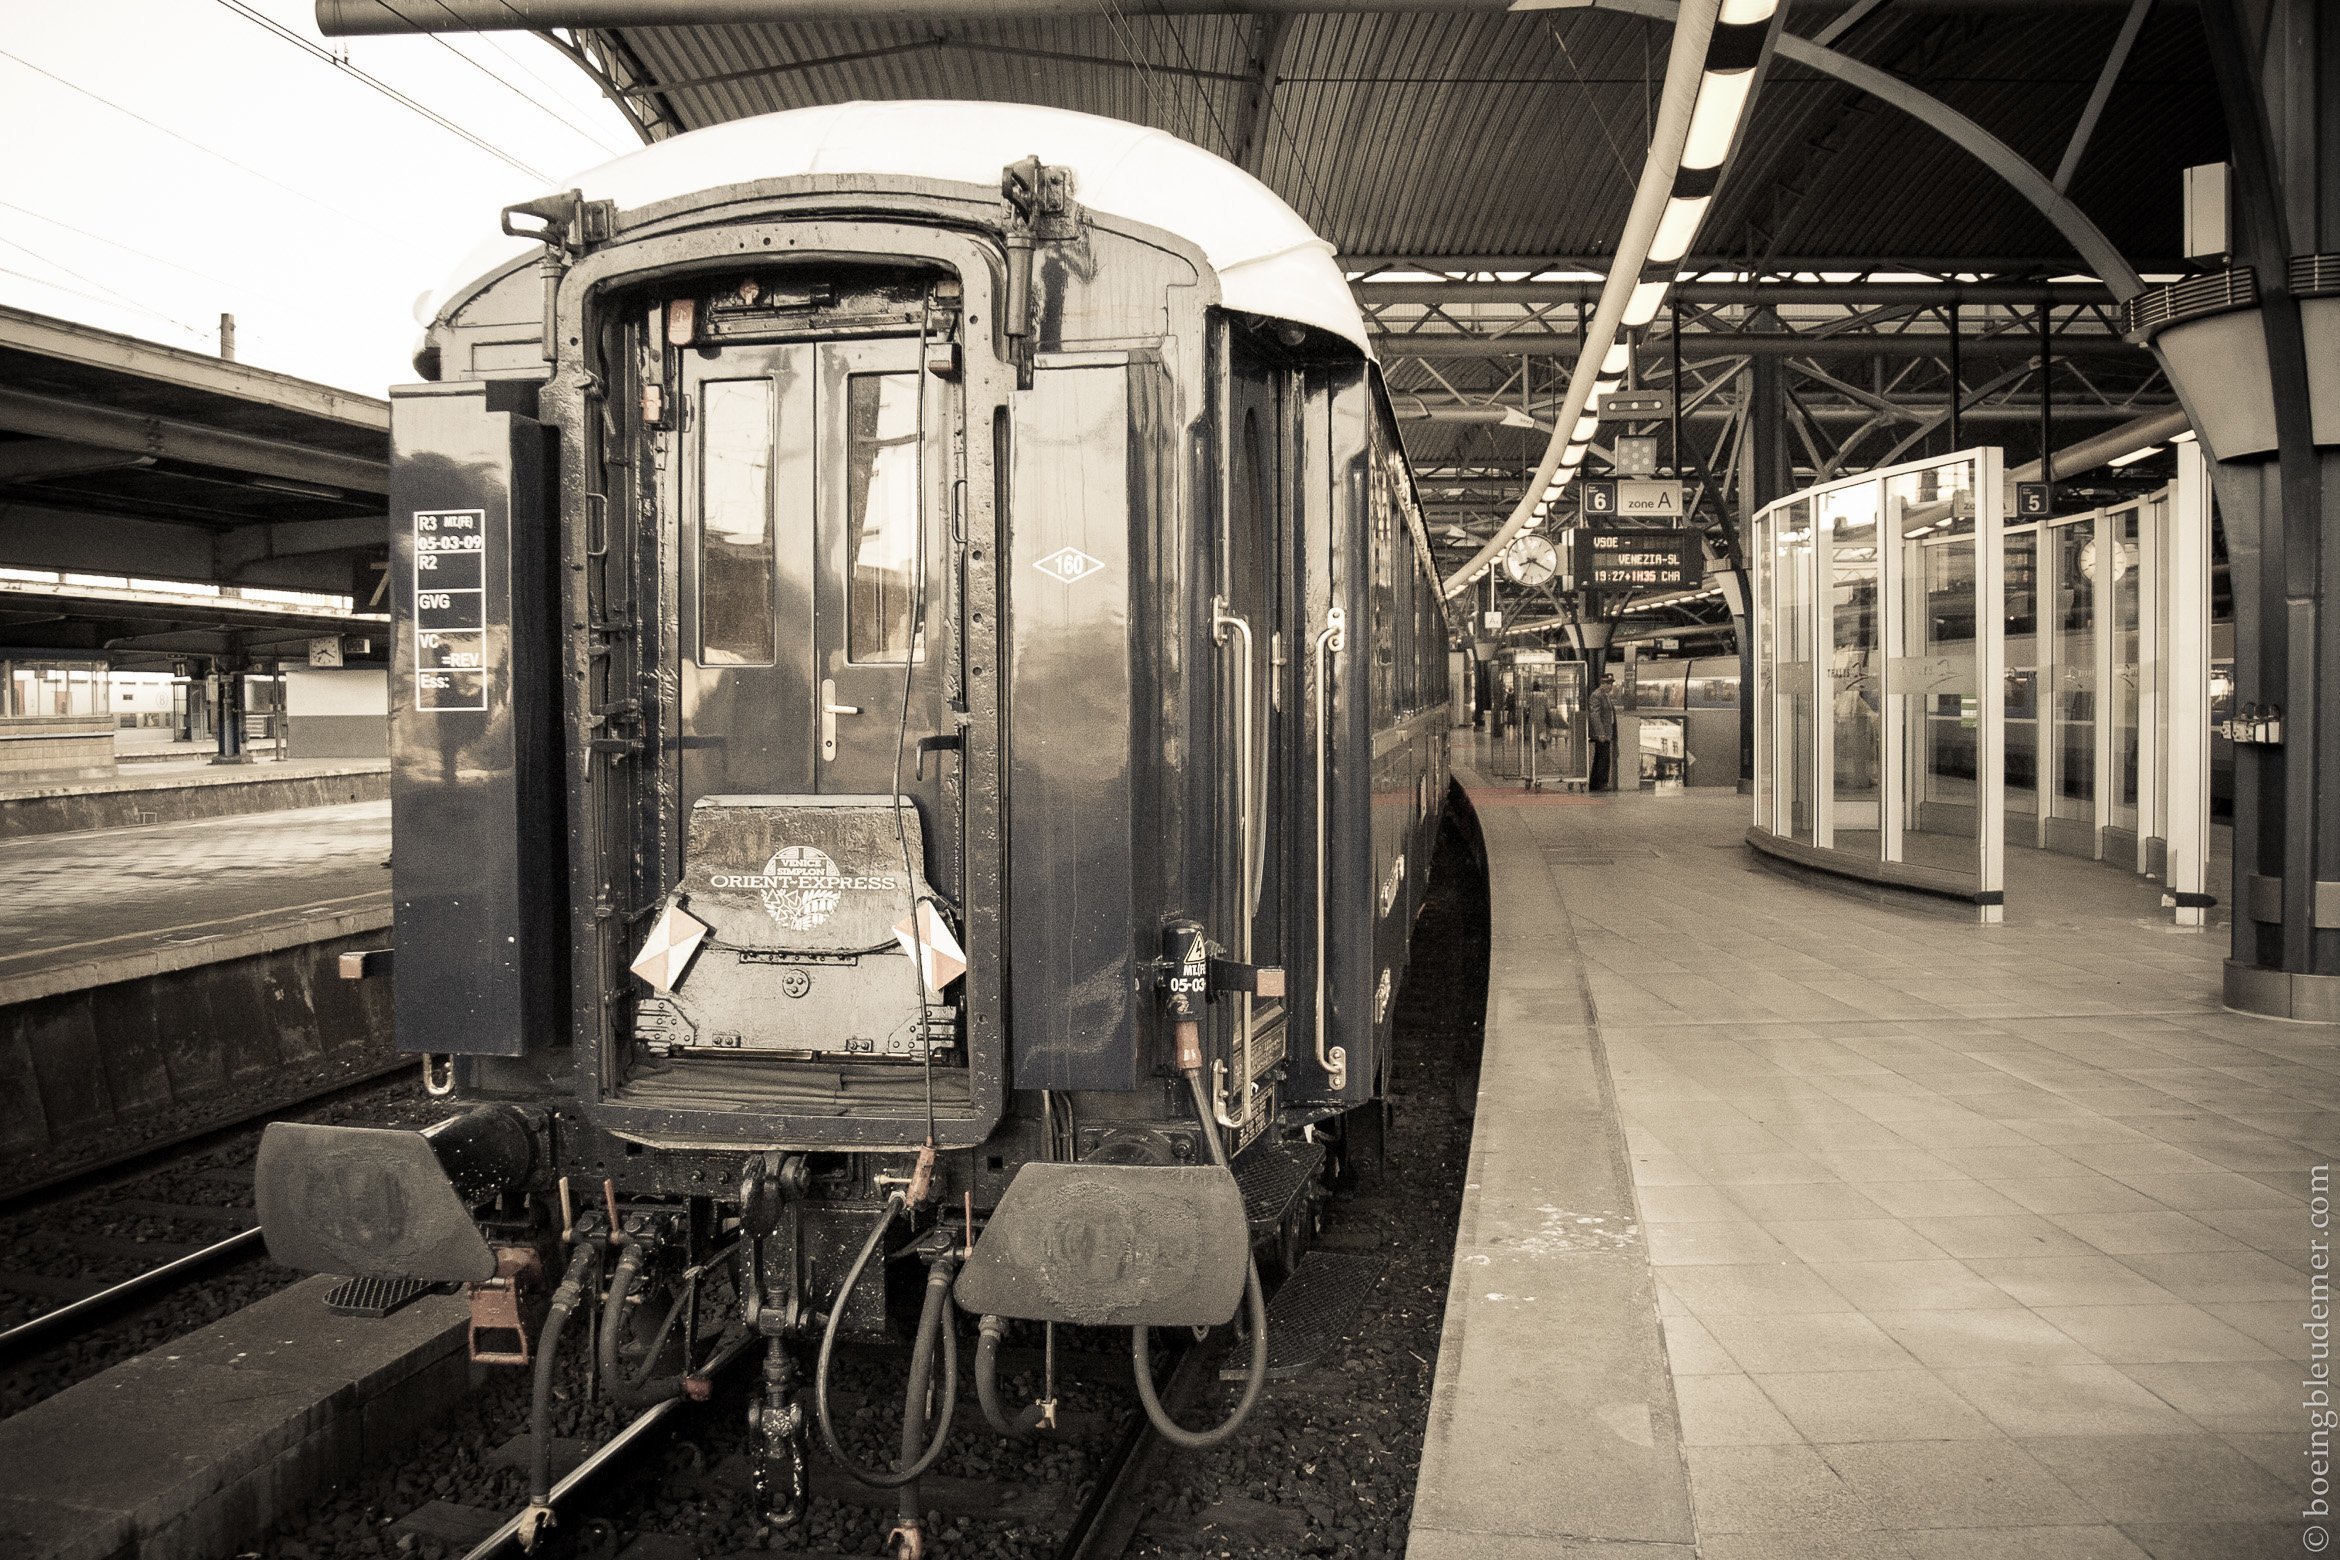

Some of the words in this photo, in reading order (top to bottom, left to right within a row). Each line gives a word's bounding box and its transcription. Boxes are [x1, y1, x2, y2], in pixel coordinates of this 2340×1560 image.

[1594, 492, 1607, 510] 6
[1628, 500, 1654, 509] zone
[1657, 491, 1672, 509] A
[2028, 494, 2040, 511] 5
[418, 516, 438, 531] R3
[418, 535, 482, 551] 05-03-09
[1593, 536, 1619, 548] VSOE
[418, 555, 438, 570] R2
[1055, 555, 1084, 575] 160
[1618, 553, 1680, 565] VENEZIA-SL
[1661, 570, 1681, 582] CHA
[418, 594, 451, 610] GVG
[419, 634, 440, 649] VC
[175, 663, 187, 677] 11
[419, 674, 450, 689] Ess:
[780, 858, 822, 868] VENICE
[776, 867, 826, 876] SIMPLON
